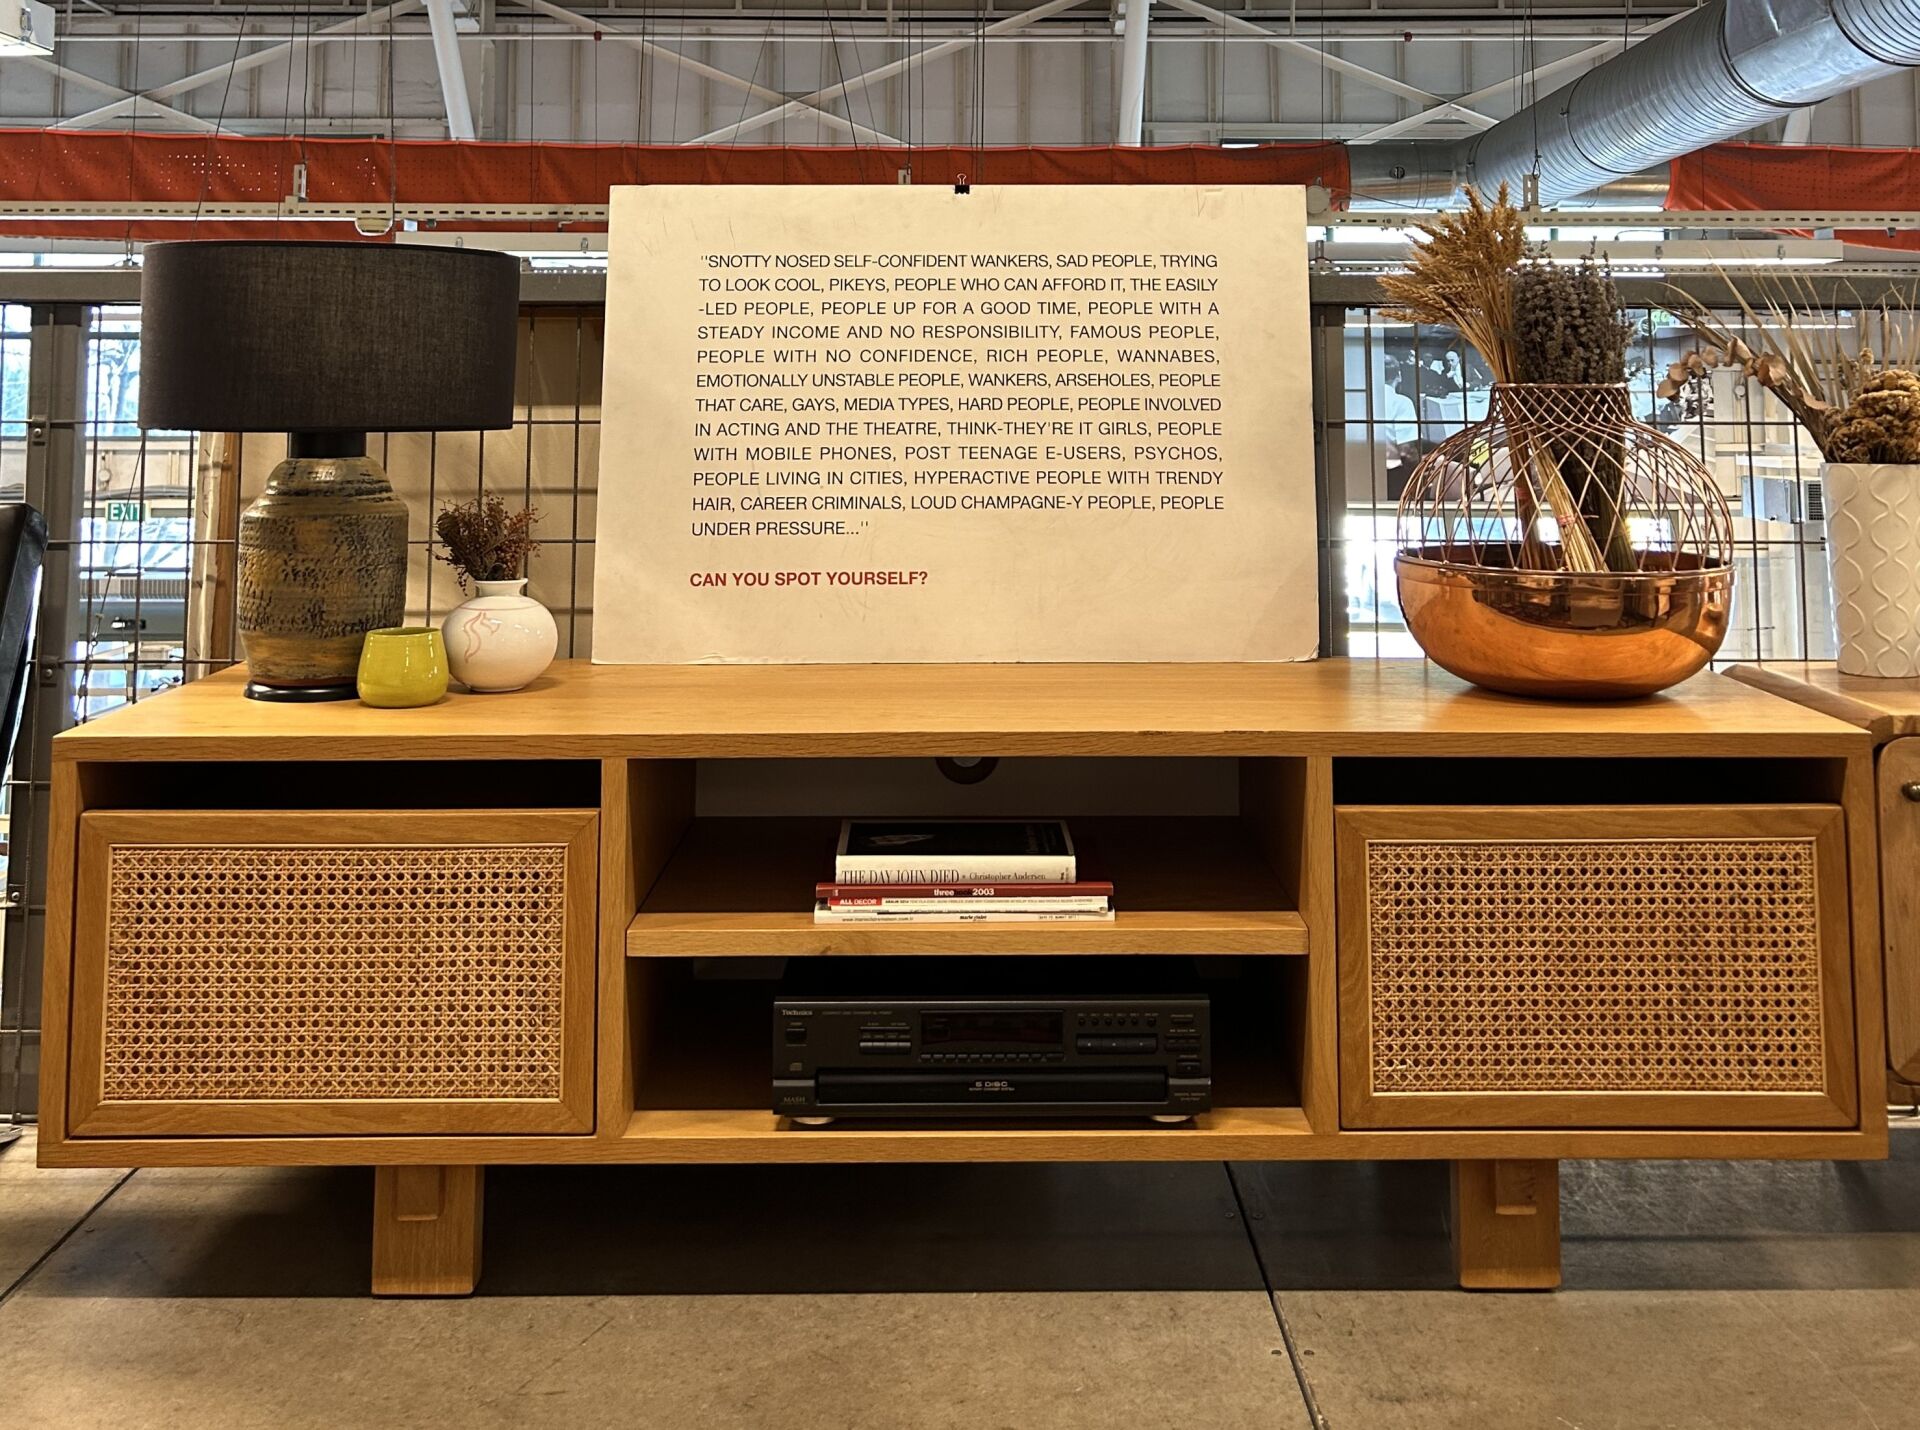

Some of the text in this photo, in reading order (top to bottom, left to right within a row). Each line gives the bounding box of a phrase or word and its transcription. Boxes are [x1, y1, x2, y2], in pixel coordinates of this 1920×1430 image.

[775, 254, 831, 268] NOSED
[833, 254, 969, 268] SELF-CONFIDENT
[970, 254, 1053, 270] WANKERS,
[1055, 254, 1089, 268] SAD
[1091, 254, 1157, 270] PEOPLE,
[1159, 254, 1218, 268] TRYING
[698, 277, 1219, 294] TO LOOK COOL, PIKEYS, PEOPLE WHO CAN AFFORD IT, THE EASILY
[698, 301, 1220, 318] -LED PEOPLE, PEOPLE UP FOR A GOOD TIME, PEOPLE WITH A
[697, 324, 1220, 342] STEADY INCOME AND NO RESPONSIBILITY, FAMOUS PEOPLE,
[697, 348, 1220, 365] PEOPLE WITH NO CONFIDENCE, RICH PEOPLE, WANNABES,
[696, 372, 1221, 390] EMOTIONALLY UNSTABLE PEOPLE, WANKERS, ARSEHOLES, PEOPLE
[694, 396, 1222, 414] THAT CARE, GAYS, MEDIA TYPES, HARD PEOPLE, PEOPLE INVOLVED
[694, 421, 1223, 438] IN ACTING AND THE THEATRE, THINK-THEY'RE IT GIRLS, PEOPLE
[693, 445, 1223, 463] WITH MOBILE PHONES, POST TEENAGE E-USERS, PSYCHOS,
[693, 470, 1224, 487] PEOPLE LIVING IN CITIES, HYPERACTIVE PEOPLE WITH TRENDY
[110, 503, 142, 520] EXIT
[692, 495, 1225, 513] HAIR, CAREER CRIMINALS, LOUD CHAMPAGNE-Y PEOPLE, PEOPLE
[691, 521, 751, 537] UNDER
[689, 570, 929, 587] CAN YOU SPOT YOURSELF?
[841, 869, 866, 884] THE
[869, 869, 892, 884] DAY
[895, 869, 927, 884] JOHN
[930, 869, 960, 884] DIED
[968, 870, 1011, 882] Christopher
[1013, 871, 1046, 881] Andersen
[933, 888, 955, 896] three
[972, 887, 995, 896] 2003
